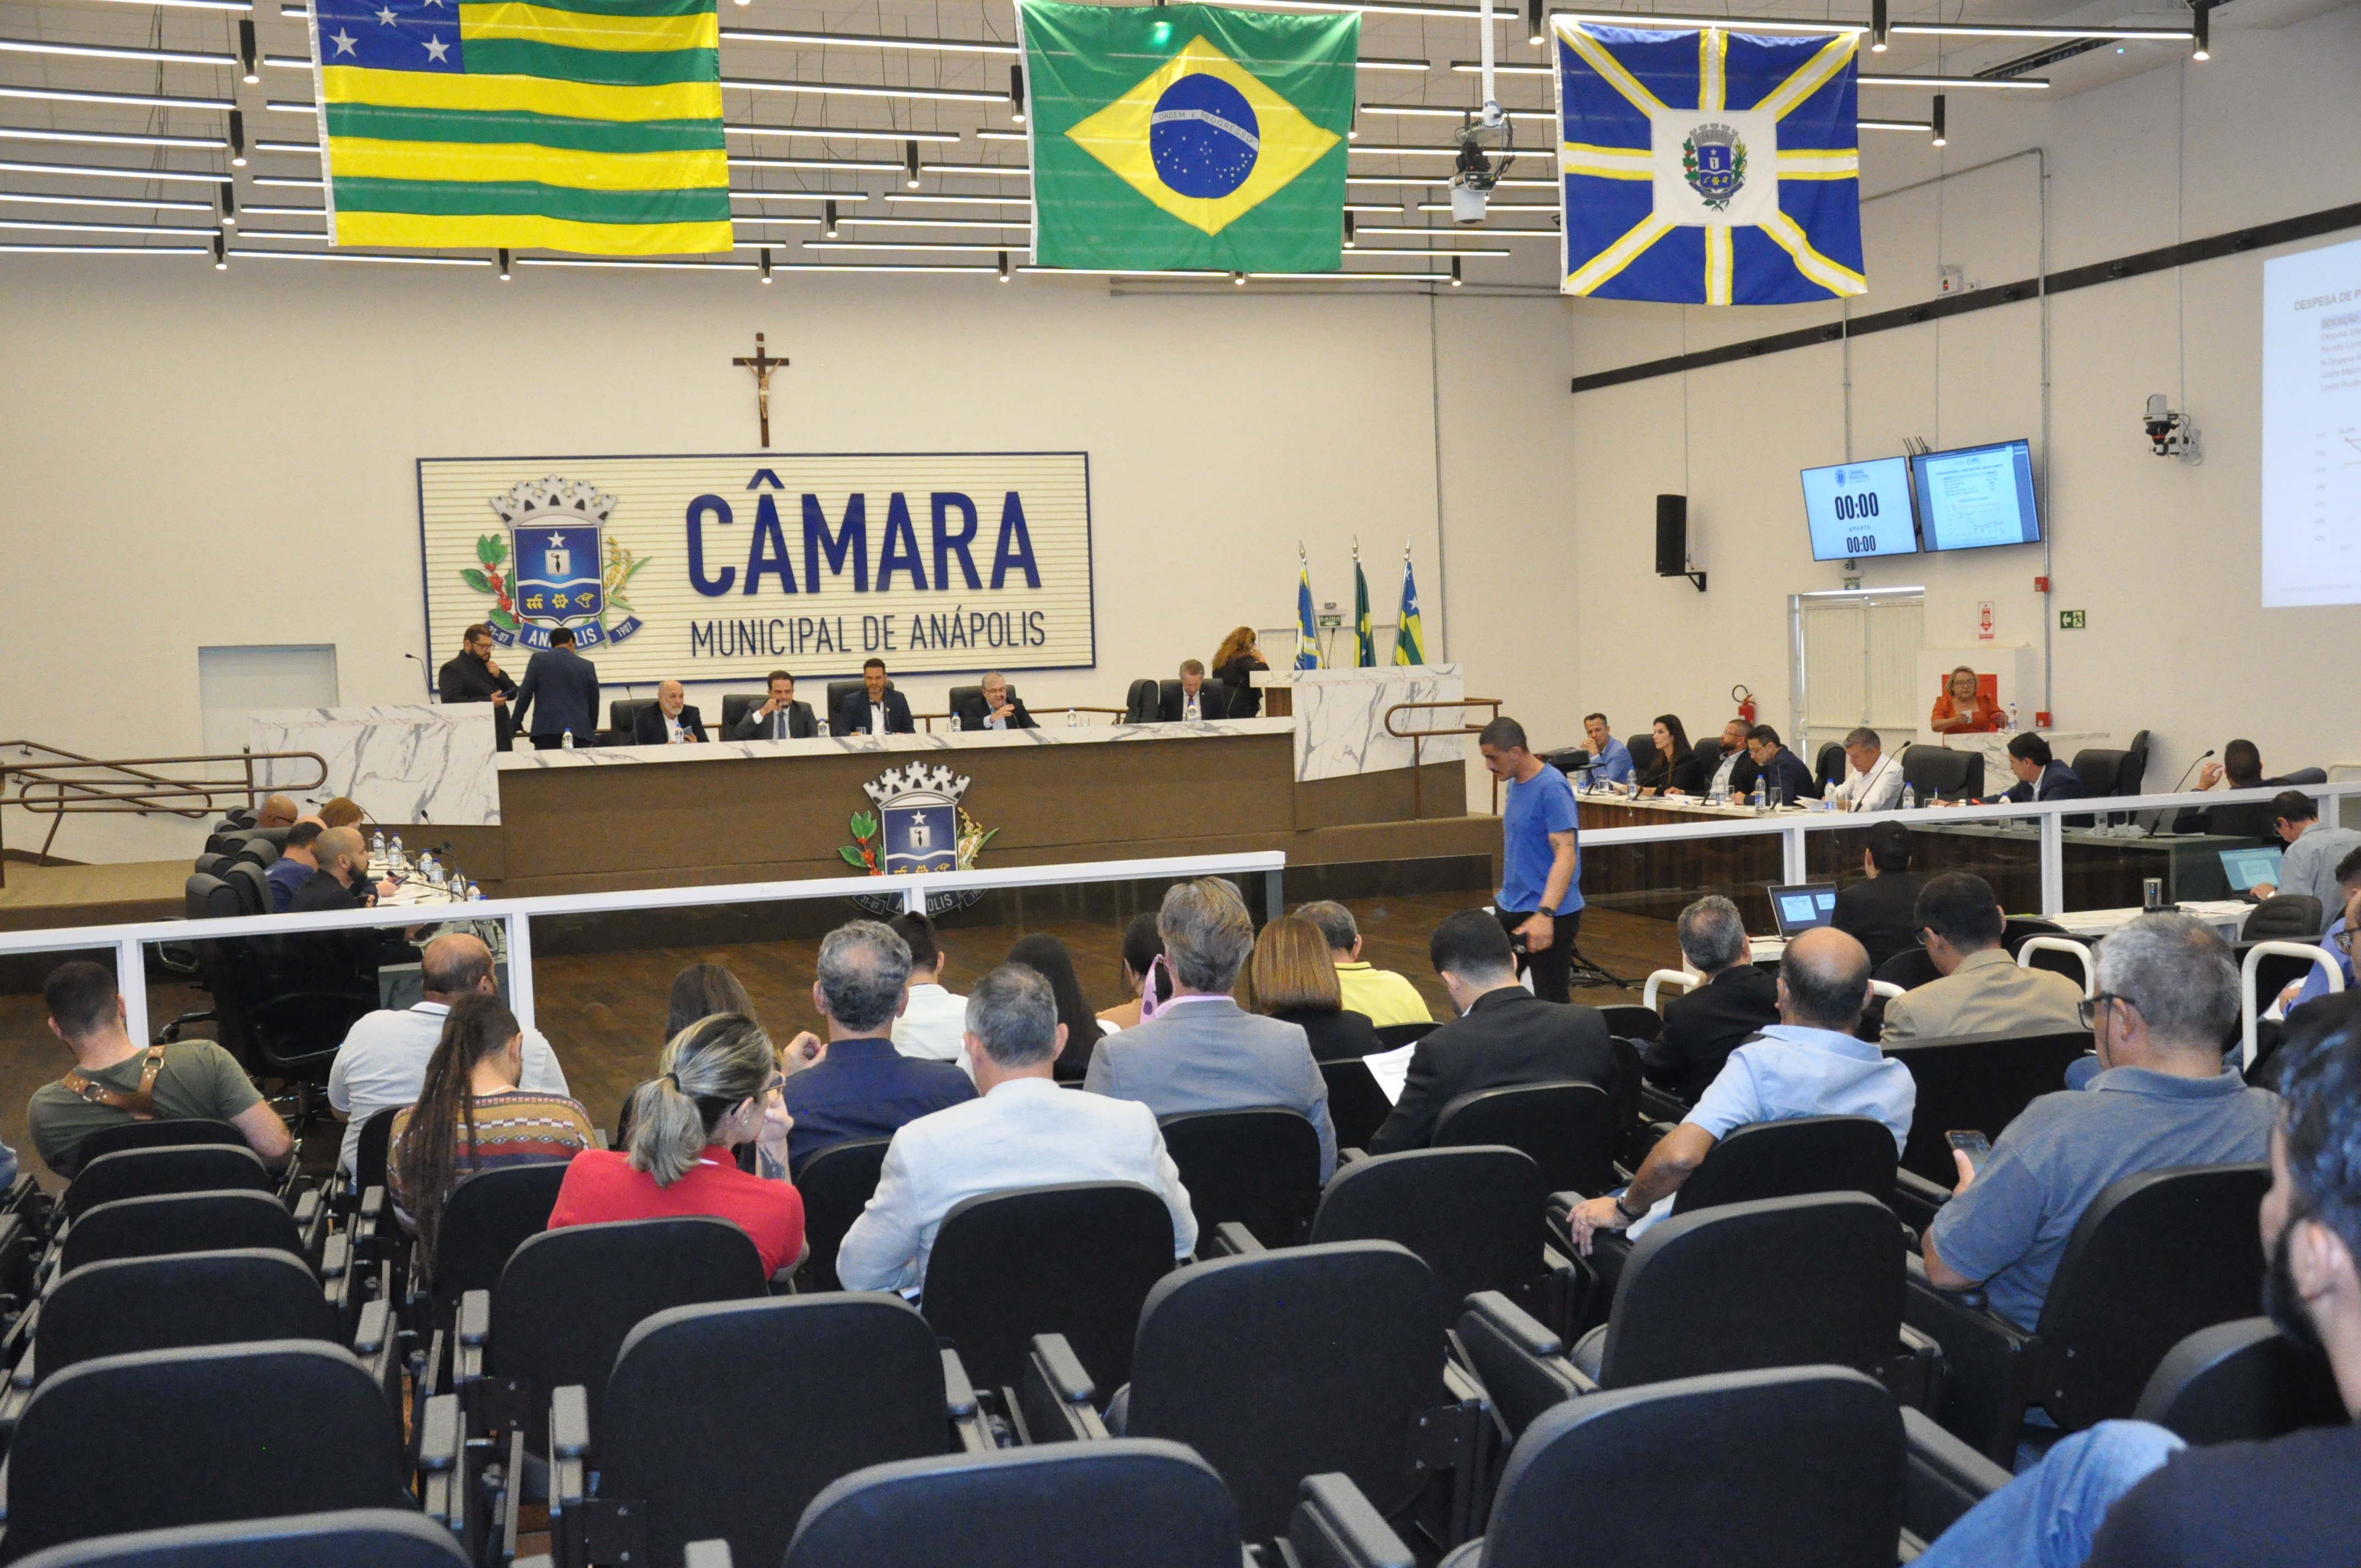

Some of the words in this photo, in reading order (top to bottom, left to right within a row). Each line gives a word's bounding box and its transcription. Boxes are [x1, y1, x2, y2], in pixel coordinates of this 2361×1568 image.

[1159, 112, 1185, 121] ORDEM
[1201, 112, 1253, 143] PROGRESSO
[2294, 294, 2337, 311] DESPESA
[2339, 290, 2352, 302] DE
[1835, 492, 1879, 520] 00:00
[686, 469, 1042, 596] CÂMARA
[1847, 535, 1876, 553] 00:00
[528, 627, 597, 648] ANLIS
[616, 622, 633, 638] 1907
[692, 616, 852, 657] MUNICIPAL
[863, 614, 897, 650] DE
[910, 605, 1046, 650] ANÁPOLIS
[895, 894, 953, 912] AOLIS
